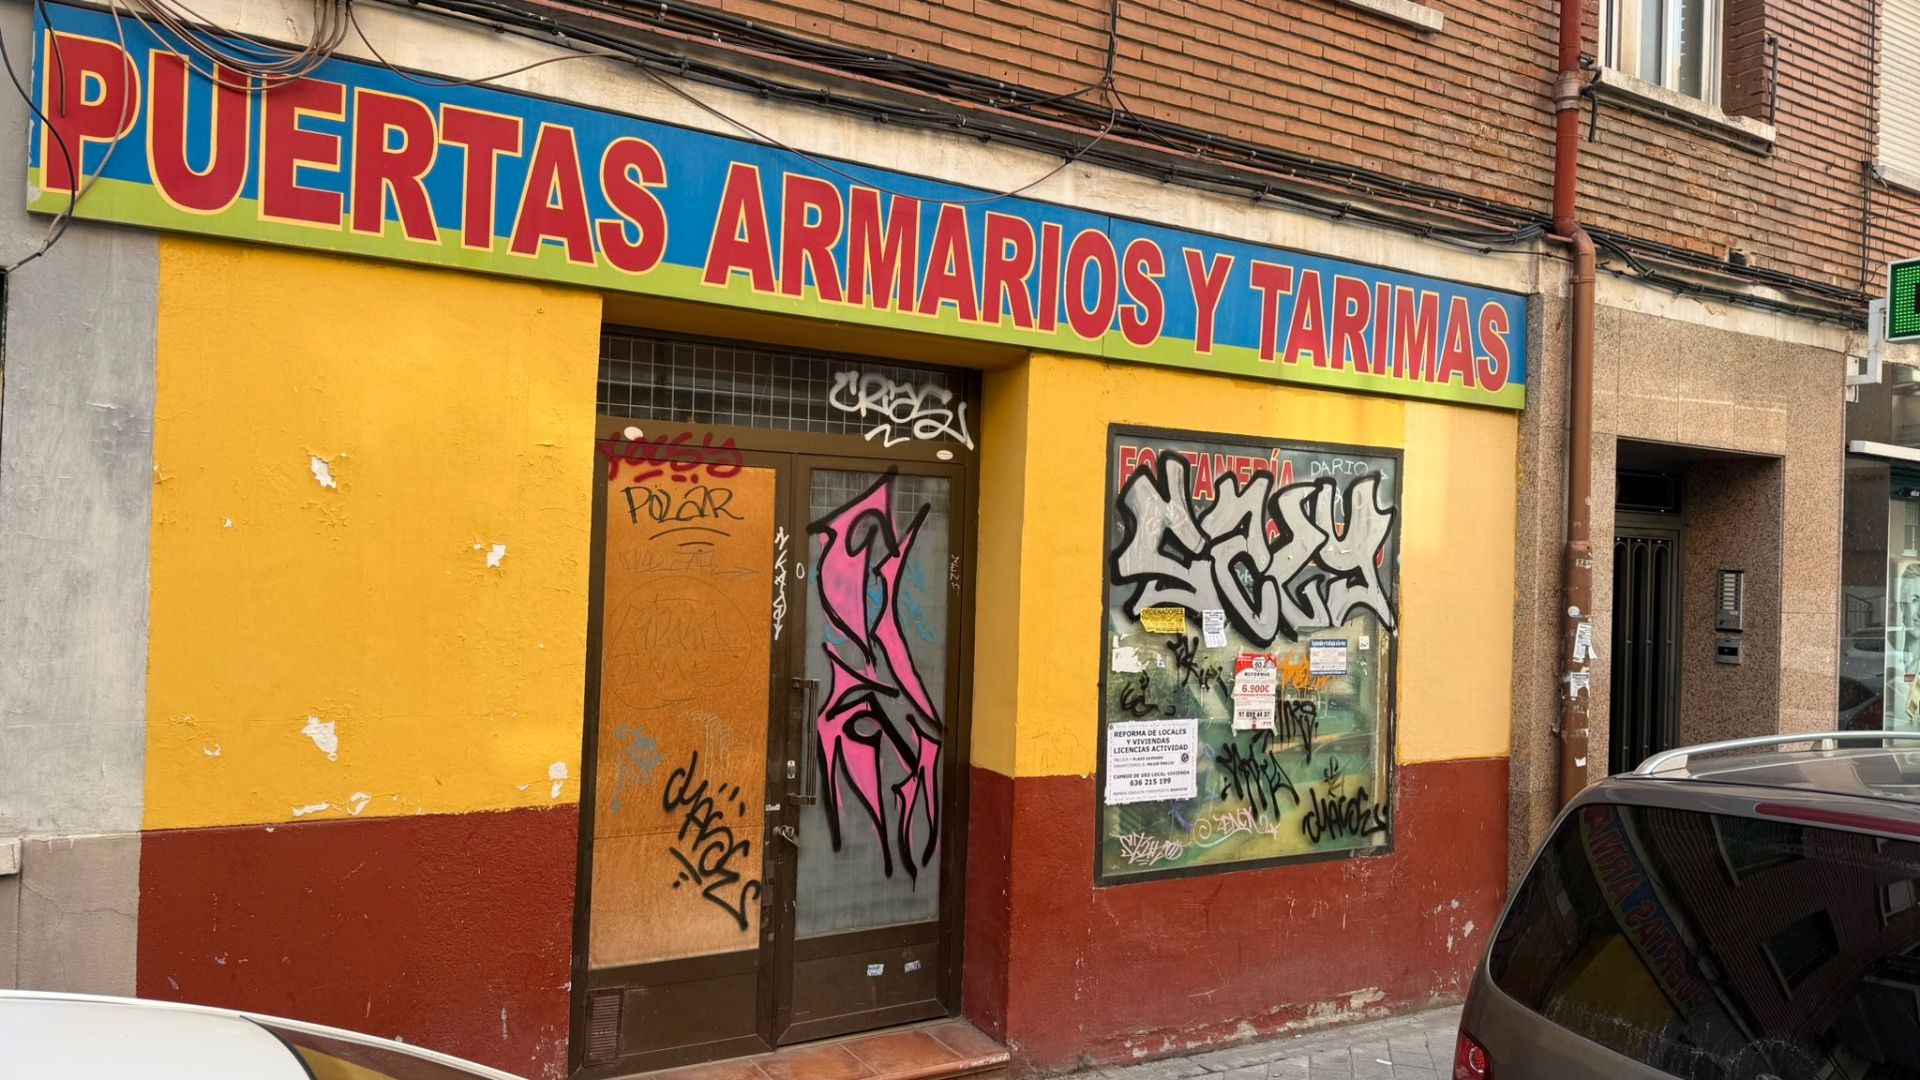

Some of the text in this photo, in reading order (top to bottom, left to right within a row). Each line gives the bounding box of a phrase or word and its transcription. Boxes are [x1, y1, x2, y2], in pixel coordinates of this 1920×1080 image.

[39, 27, 1511, 394] PUERTAS ARMARIOS Y TARIMAS
[1117, 446, 1295, 500] FOTANERÍA
[1310, 457, 1369, 477] DARIO
[620, 485, 744, 524] POLAR
[1132, 737, 1170, 745] VIVIENDAS
[1158, 728, 1187, 736] LOCALES
[1113, 744, 1188, 754] LICENCIAS ACTIVIDAD
